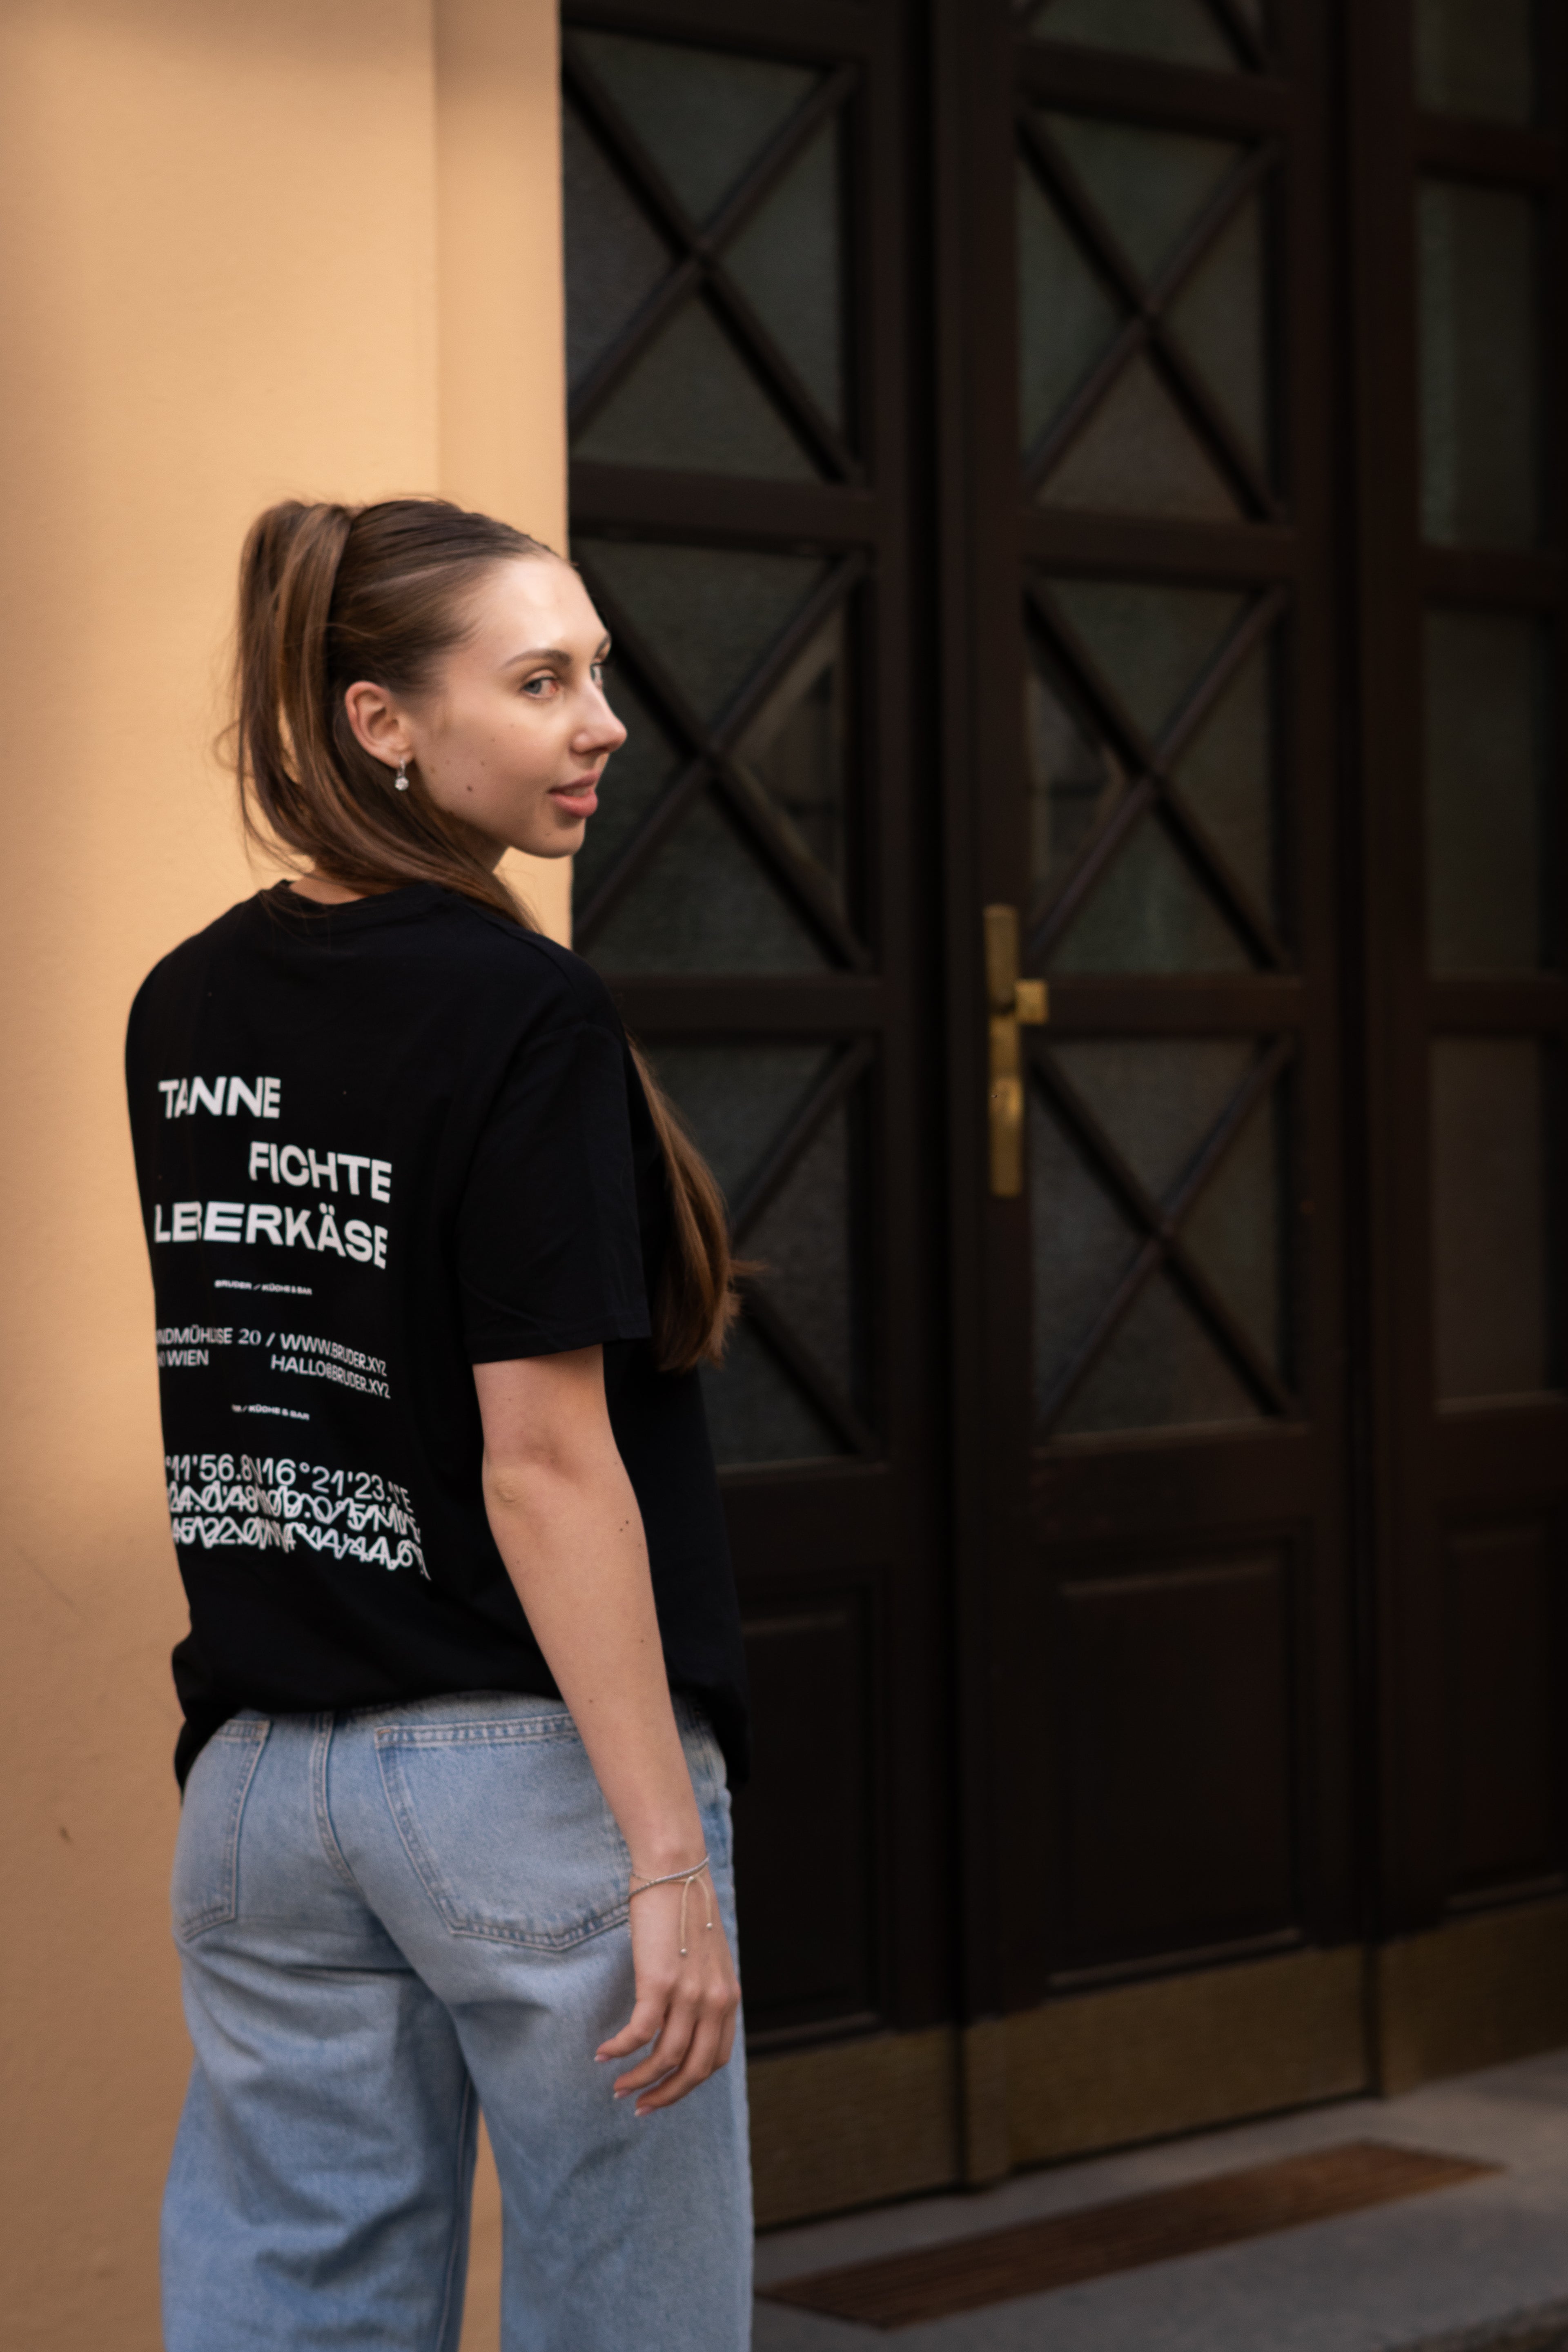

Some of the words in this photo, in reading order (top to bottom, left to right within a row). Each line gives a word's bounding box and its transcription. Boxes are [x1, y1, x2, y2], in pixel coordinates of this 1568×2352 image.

[158, 1076, 281, 1119] TANNE
[248, 1141, 392, 1203] FICHTE
[297, 1286, 312, 1295] BAR
[166, 1349, 209, 1366] WIEN
[238, 1328, 261, 1345] 20
[265, 1332, 276, 1347] /
[280, 1333, 387, 1376] WWW.BRUDER.XYZ
[290, 1410, 310, 1421] BAR
